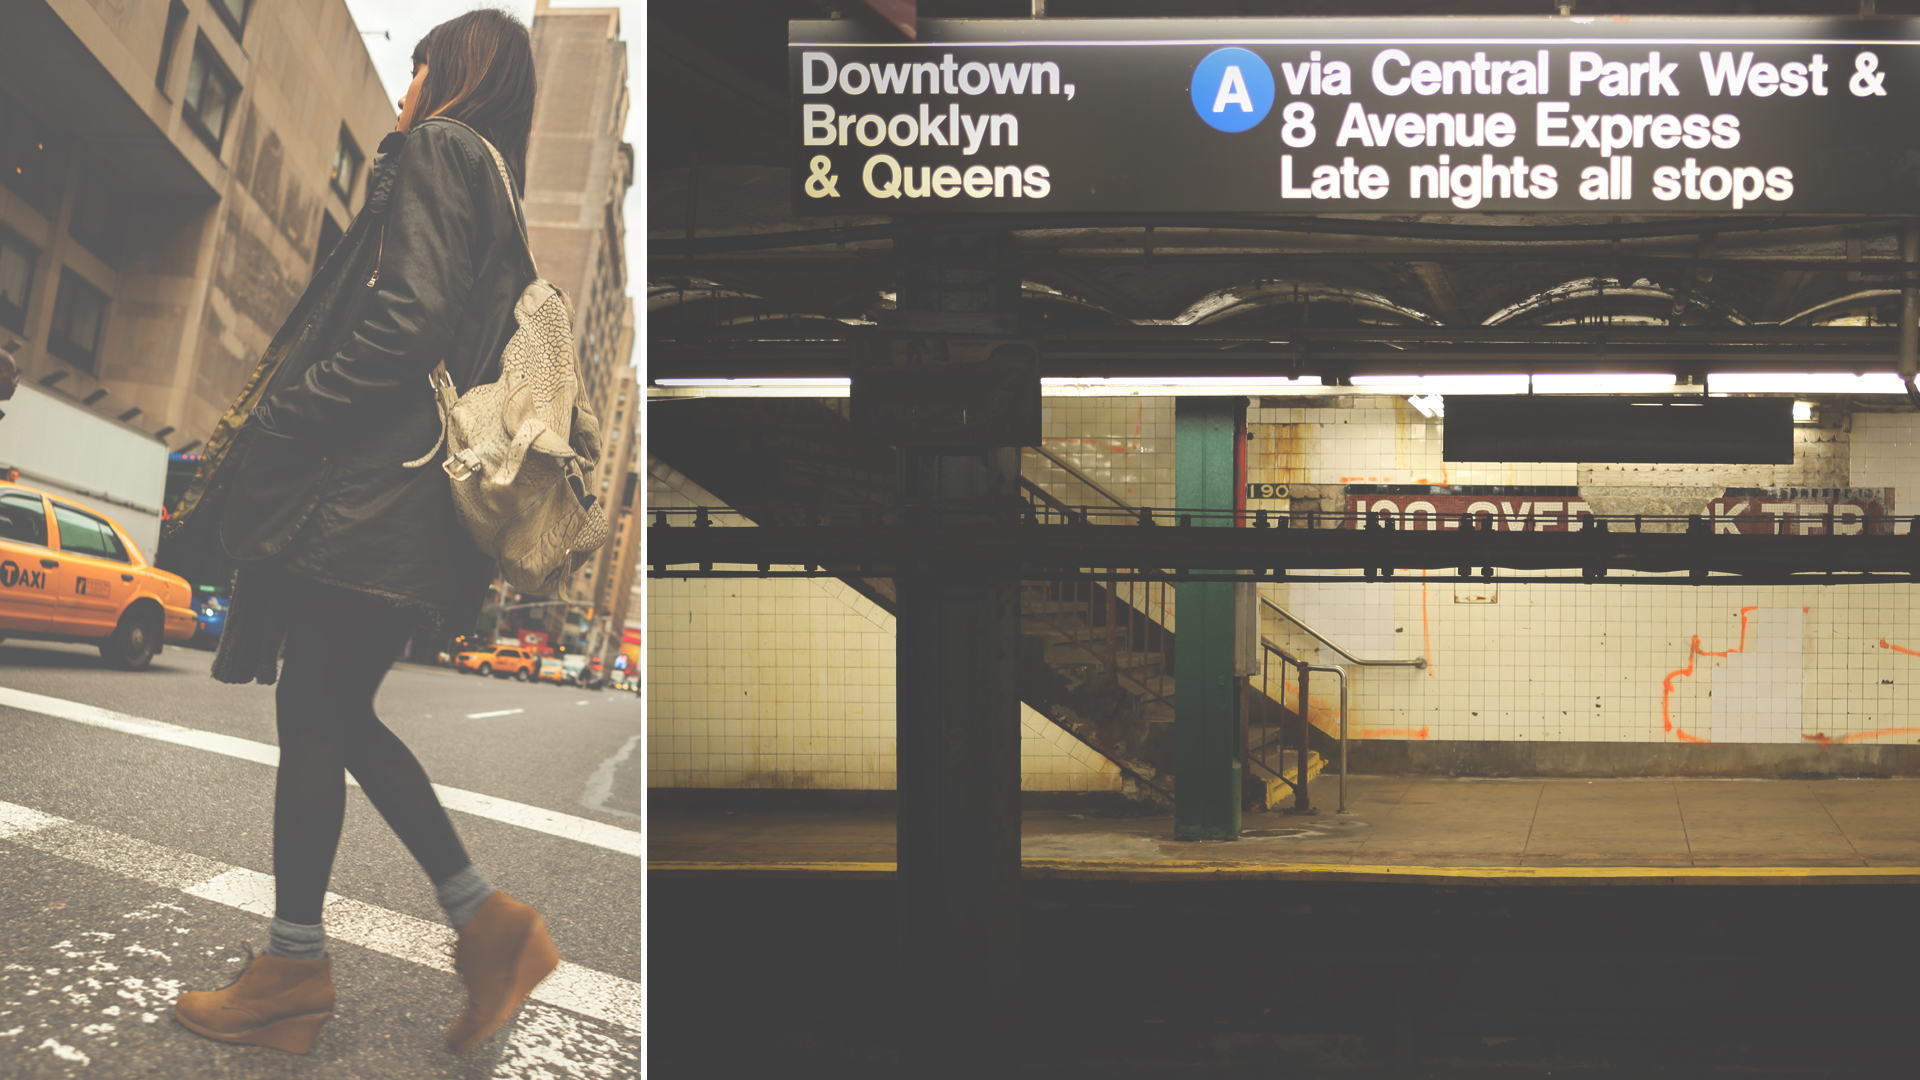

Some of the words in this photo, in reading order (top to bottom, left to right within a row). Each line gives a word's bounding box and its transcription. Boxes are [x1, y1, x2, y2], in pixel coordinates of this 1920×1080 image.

[803, 52, 1075, 101] Downtown,
[1212, 66, 1254, 113] A
[1281, 51, 1352, 96] via
[1371, 49, 1549, 96] Central
[1569, 51, 1680, 96] Park
[1699, 51, 1829, 97] West
[1849, 51, 1887, 97] &
[803, 103, 1019, 156] Brooklyn
[1281, 102, 1316, 148] 8
[1335, 102, 1517, 148] Avenue
[1536, 102, 1741, 158] Express
[804, 155, 841, 199] &
[862, 155, 1051, 200] Queens
[1281, 154, 1390, 200] Late
[1410, 153, 1559, 209] nights
[1579, 153, 1632, 201] all
[1652, 157, 1794, 210] stops
[1250, 484, 1289, 498] 190
[1, 560, 46, 590] TAXI
